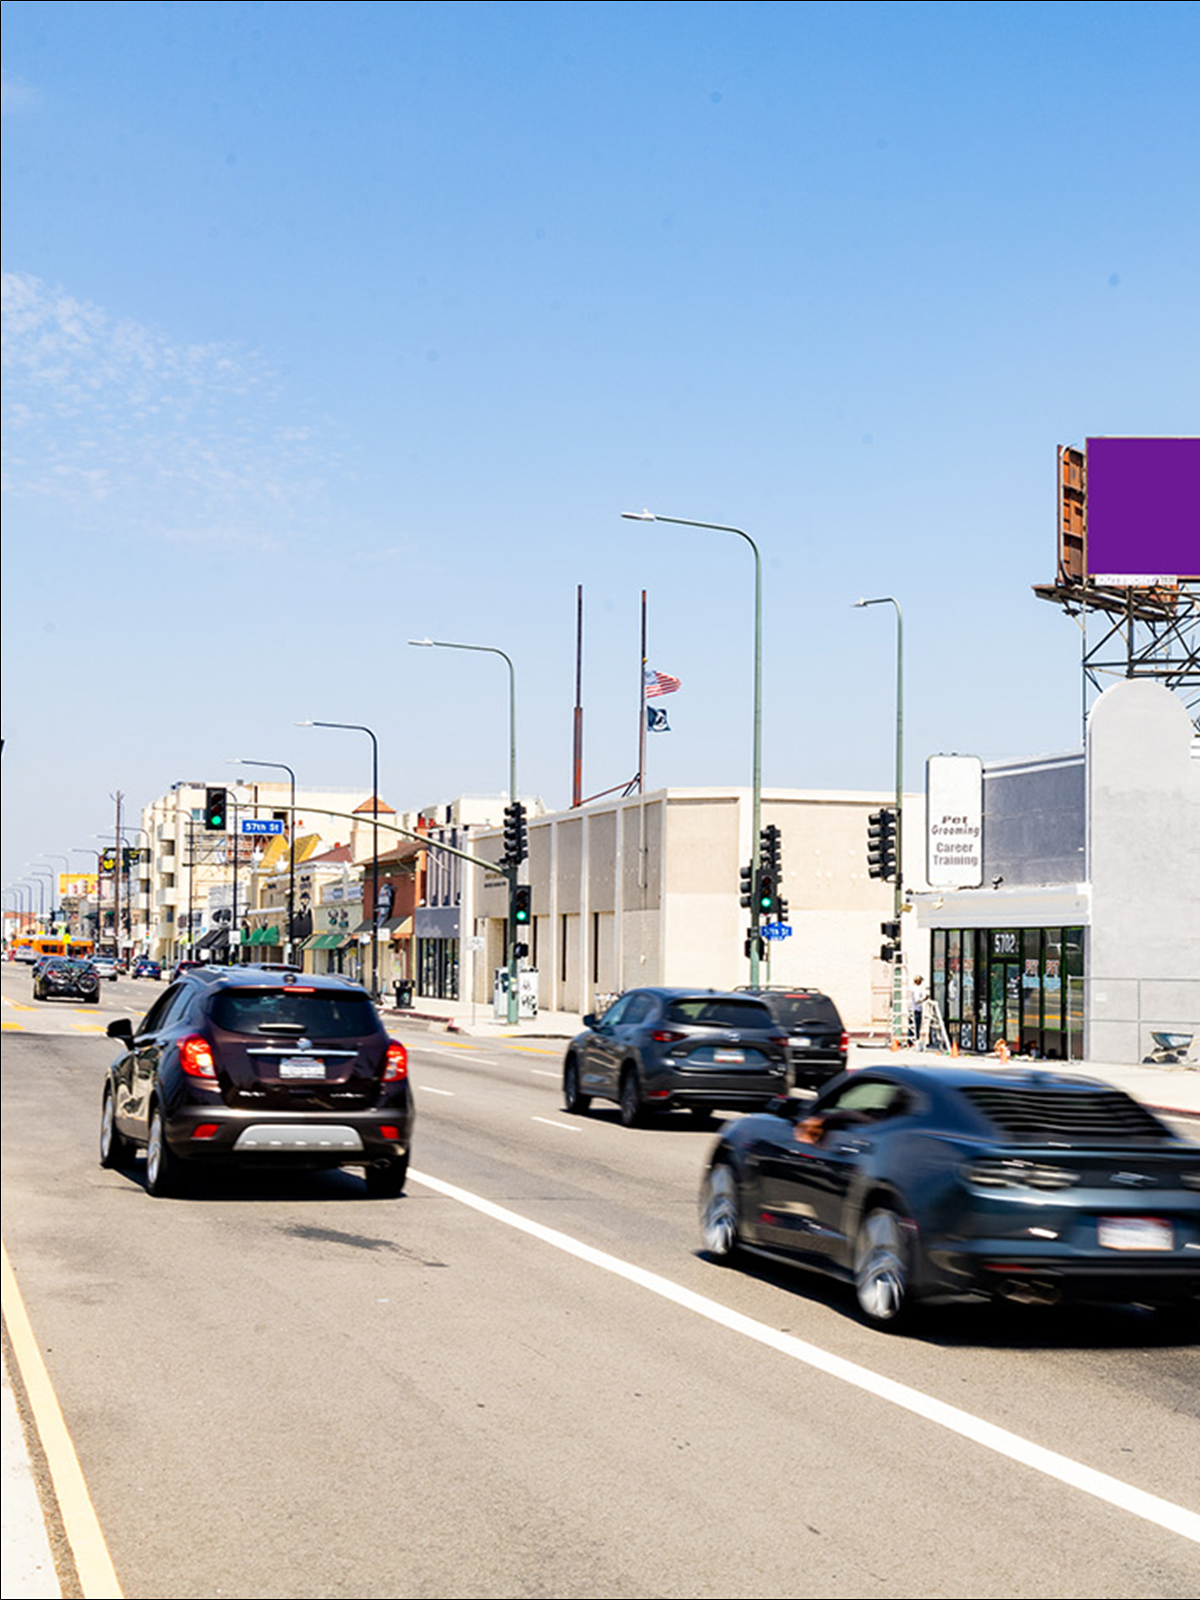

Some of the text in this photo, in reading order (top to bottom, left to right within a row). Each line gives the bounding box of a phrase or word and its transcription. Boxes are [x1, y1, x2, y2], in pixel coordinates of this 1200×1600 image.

[942, 815, 967, 824] Pet
[245, 822, 279, 832] 57th St
[931, 824, 980, 838] Grooming
[936, 842, 973, 853] Career
[932, 854, 978, 867] Training
[994, 933, 1015, 953] 5702
